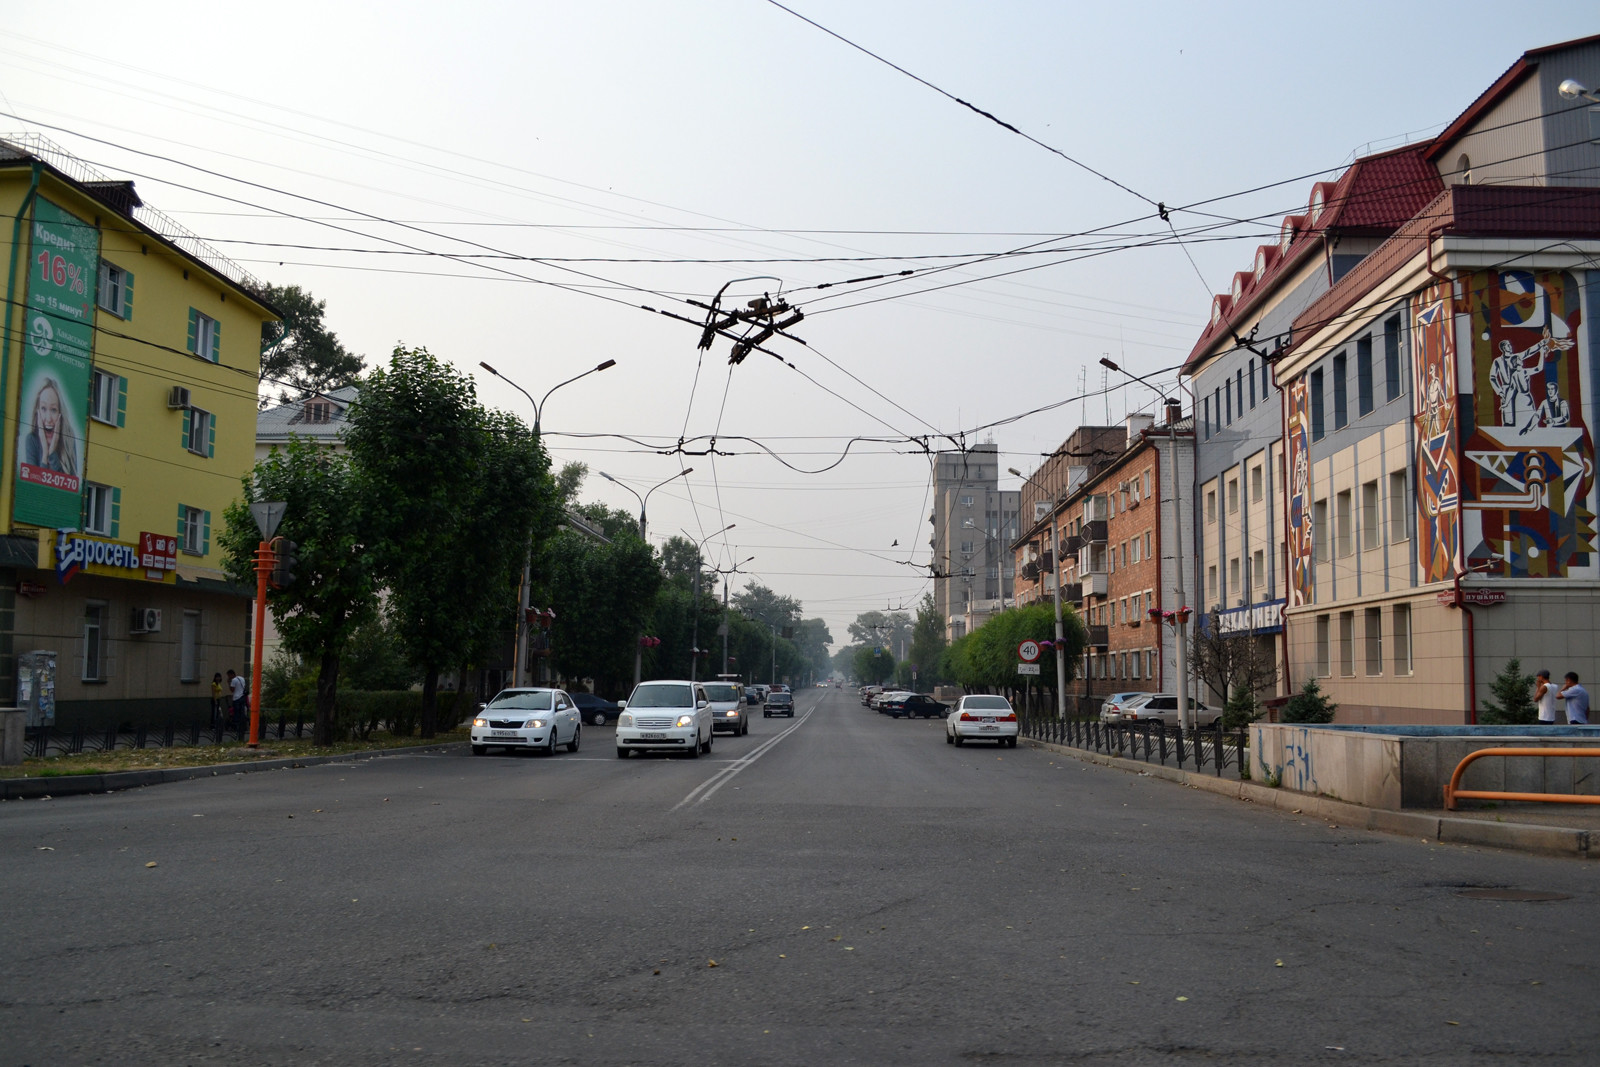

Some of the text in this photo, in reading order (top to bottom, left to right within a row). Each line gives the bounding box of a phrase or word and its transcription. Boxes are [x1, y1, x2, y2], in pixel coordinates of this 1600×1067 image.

[35, 223, 76, 253] Кредит
[38, 249, 84, 295] 16%
[35, 294, 46, 304] за
[47, 296, 58, 308] 15
[41, 471, 77, 490] 32-07-70
[56, 527, 140, 572] Евросеть
[1023, 645, 1036, 656] 40
